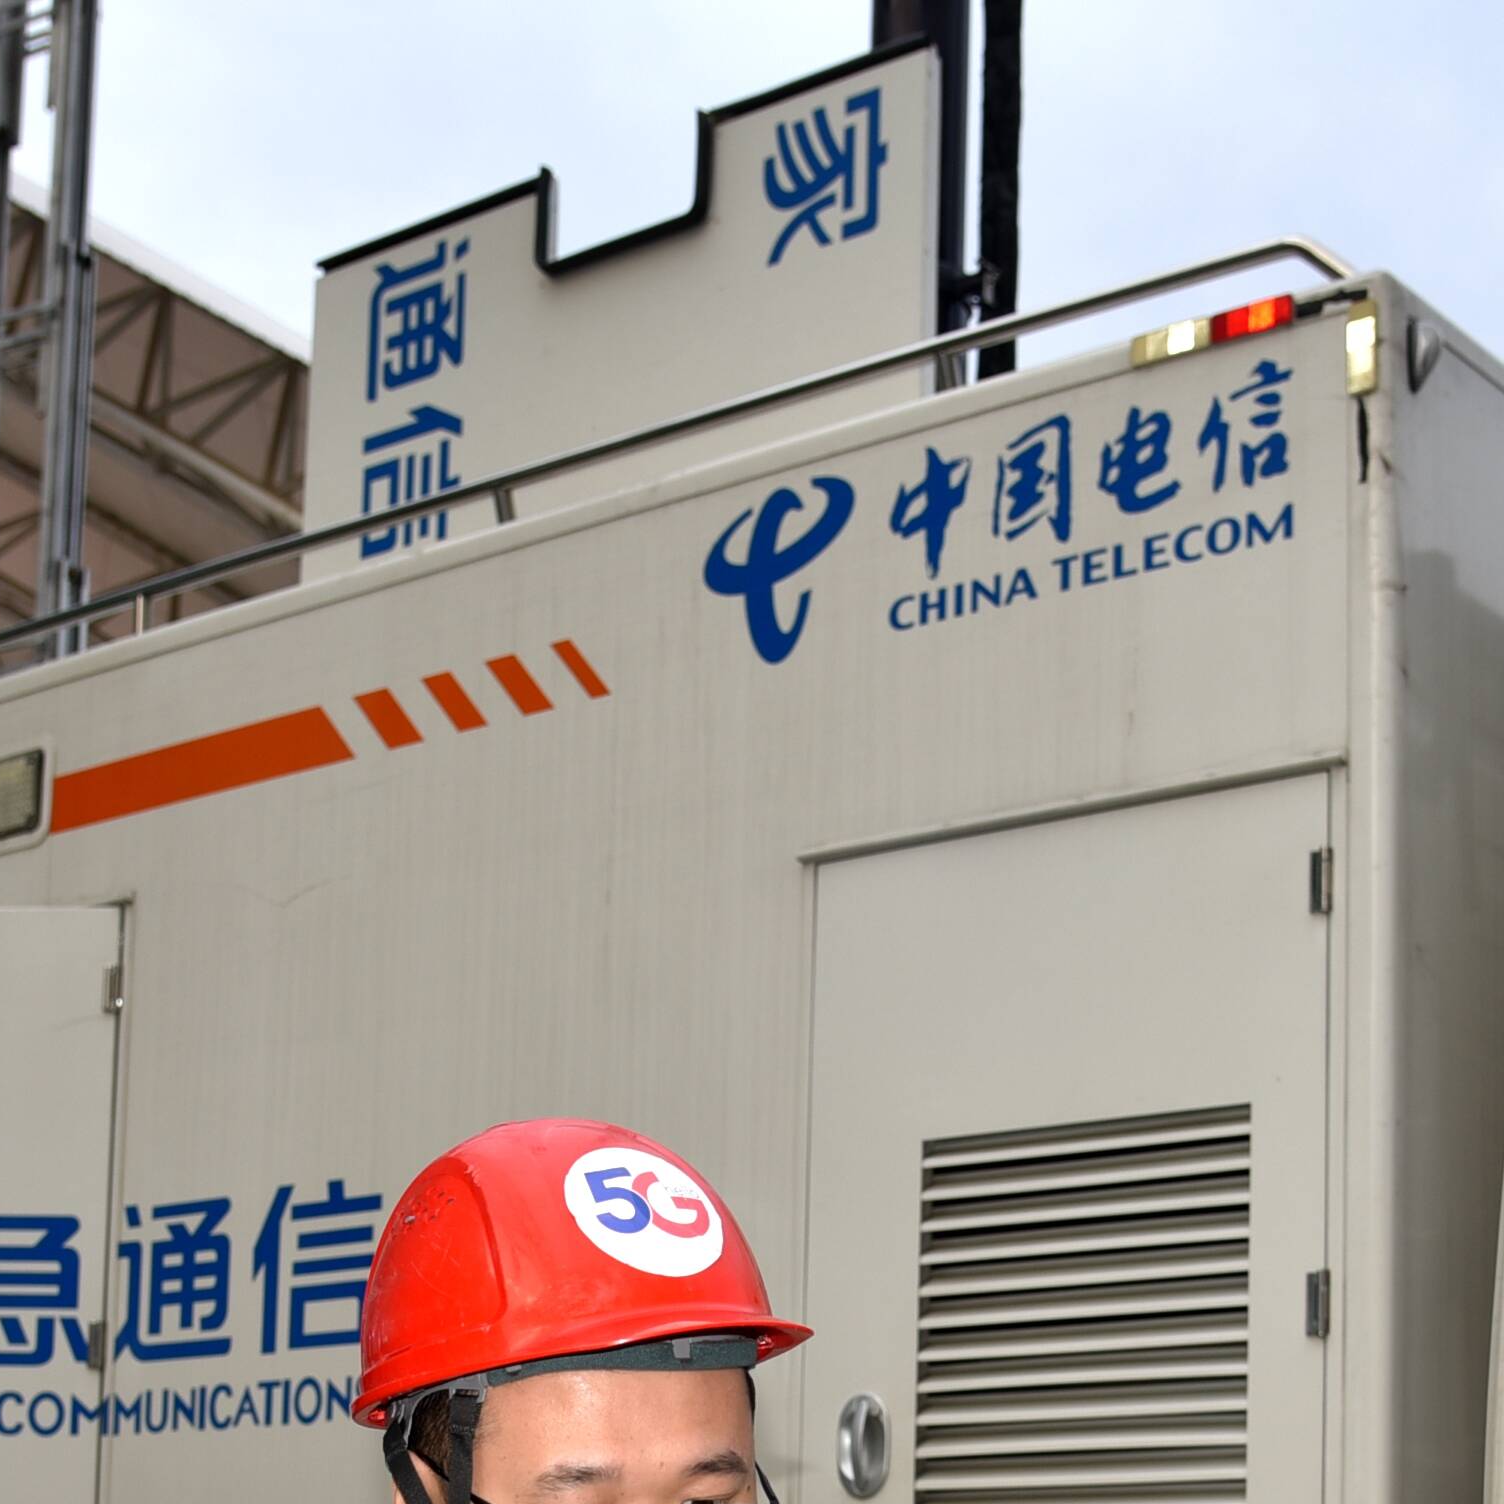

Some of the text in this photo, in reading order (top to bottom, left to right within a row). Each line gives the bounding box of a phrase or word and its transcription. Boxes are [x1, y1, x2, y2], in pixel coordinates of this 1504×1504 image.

[763, 86, 888, 268] 家
[360, 236, 470, 560] 通信
[888, 358, 1294, 580] 中国电信
[887, 502, 1296, 632] CHINA TELECOM
[584, 1166, 710, 1239] 5G
